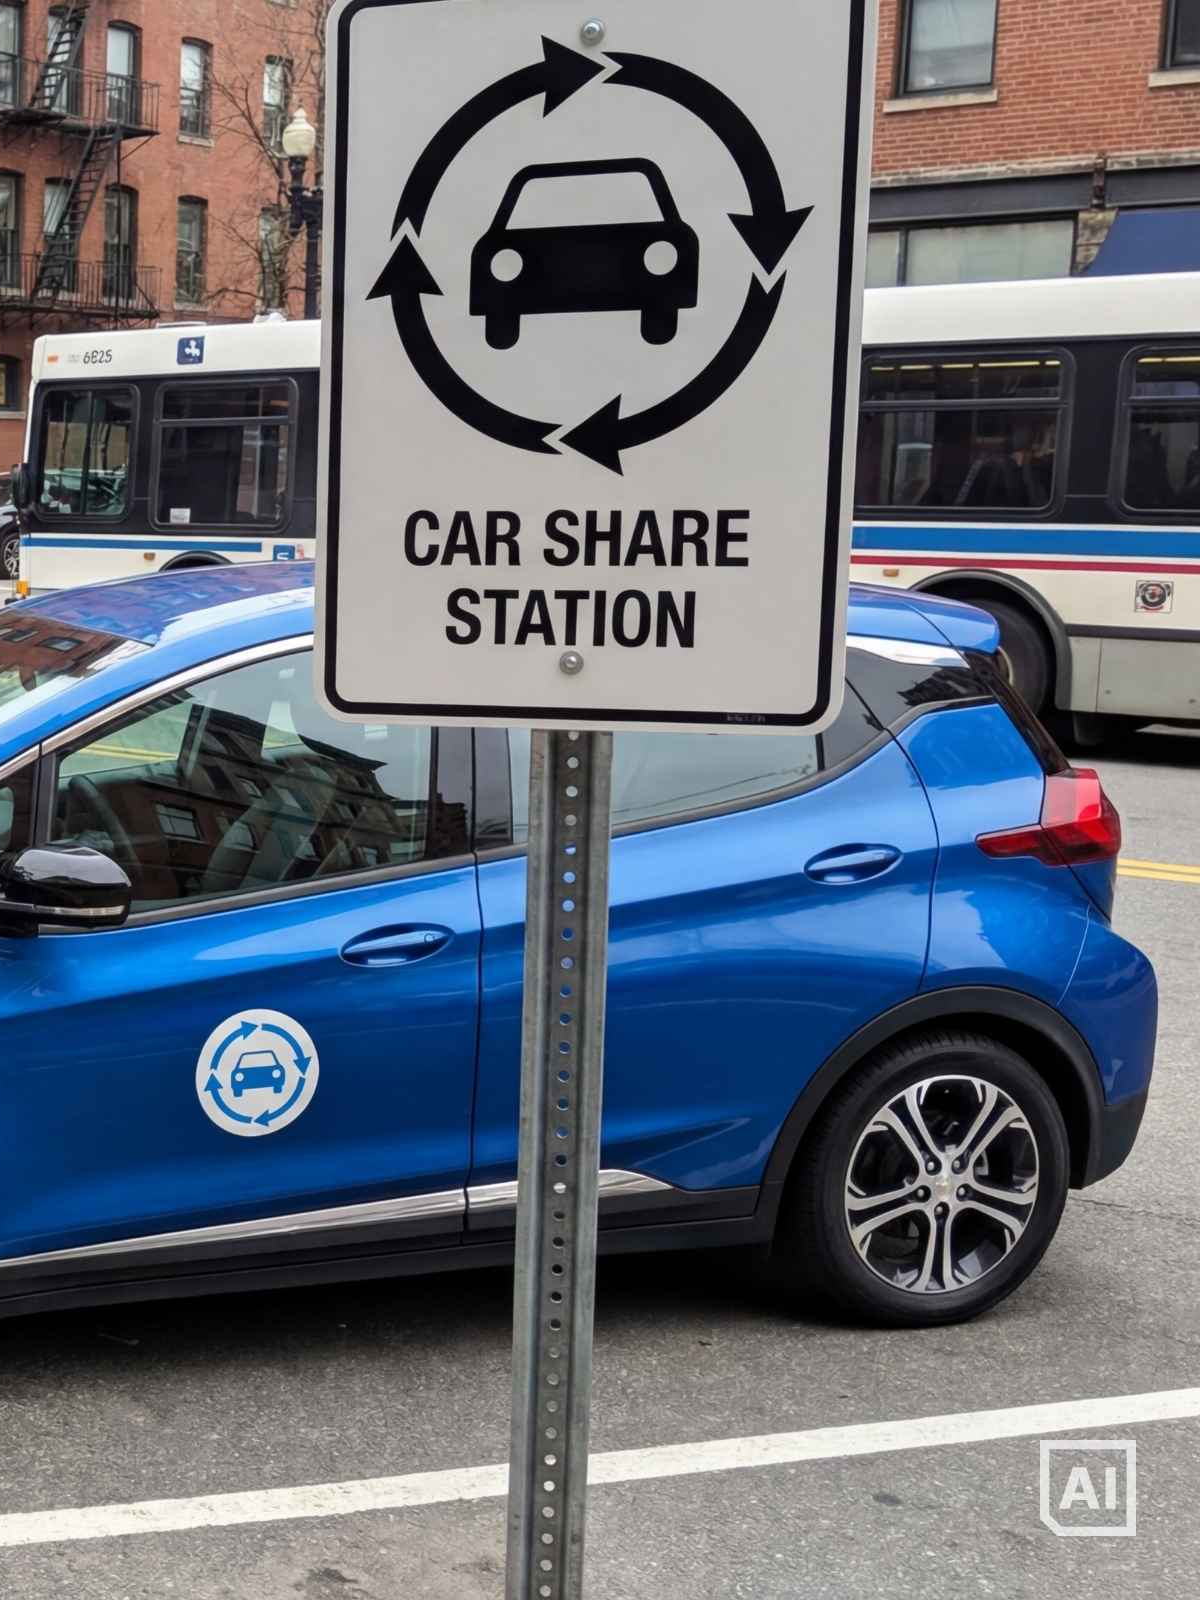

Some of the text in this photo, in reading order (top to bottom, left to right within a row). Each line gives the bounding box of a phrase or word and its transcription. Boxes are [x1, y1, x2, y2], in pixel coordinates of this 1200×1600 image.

[404, 509, 750, 567] CAR SHARE
[445, 588, 697, 648] STATION
